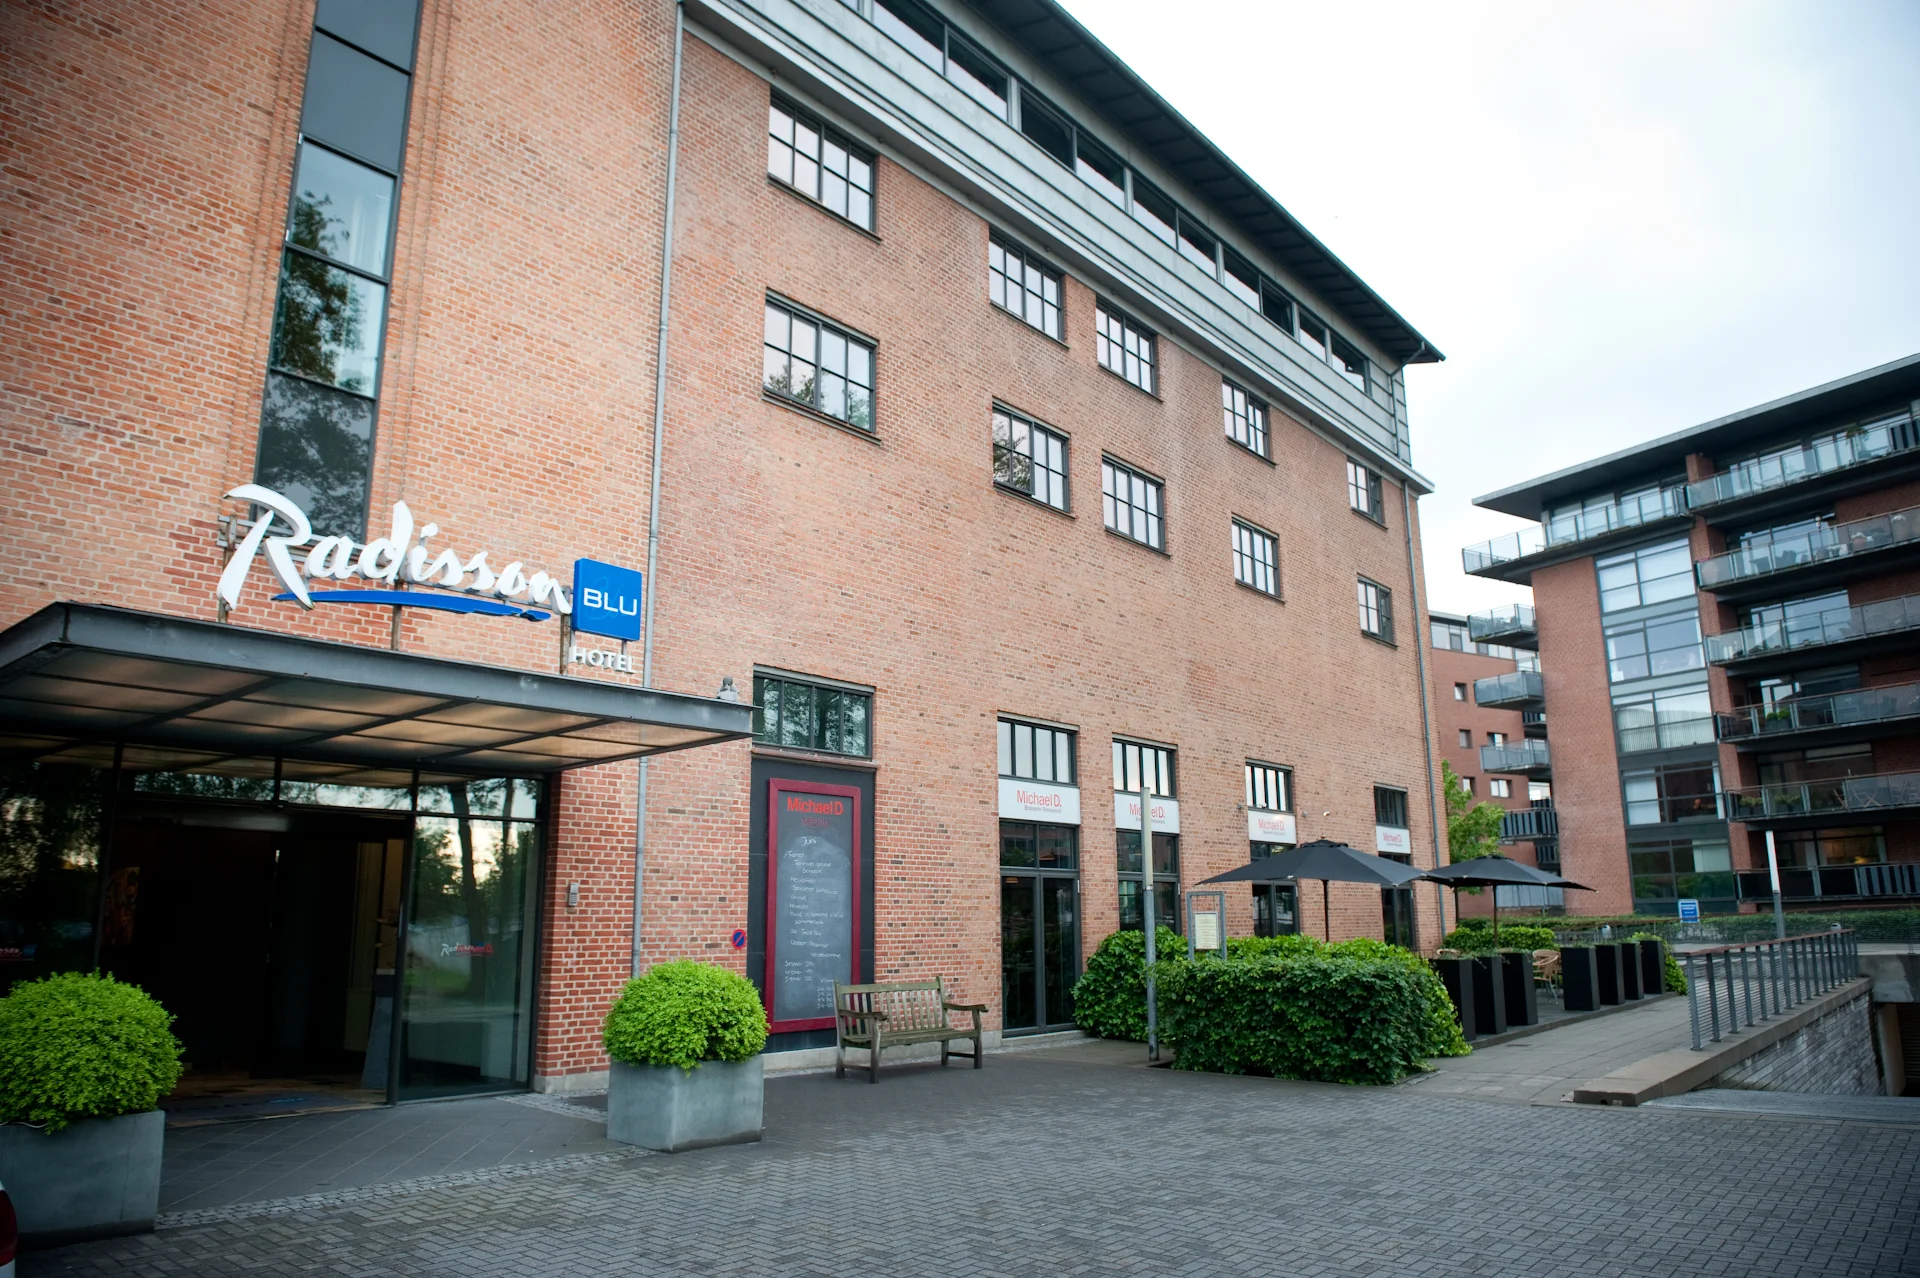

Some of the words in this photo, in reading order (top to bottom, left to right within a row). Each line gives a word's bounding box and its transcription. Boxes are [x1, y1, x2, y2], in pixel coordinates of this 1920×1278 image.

[217, 484, 572, 615] Radisson
[583, 587, 638, 616] BLU
[569, 646, 636, 674] HOTEL
[787, 796, 833, 815] Michael
[834, 801, 844, 815] D
[1016, 789, 1052, 807] Michael
[1053, 794, 1062, 808] D.
[1129, 803, 1158, 818] Micel
[1158, 806, 1166, 819] D.
[801, 817, 830, 828] MENU
